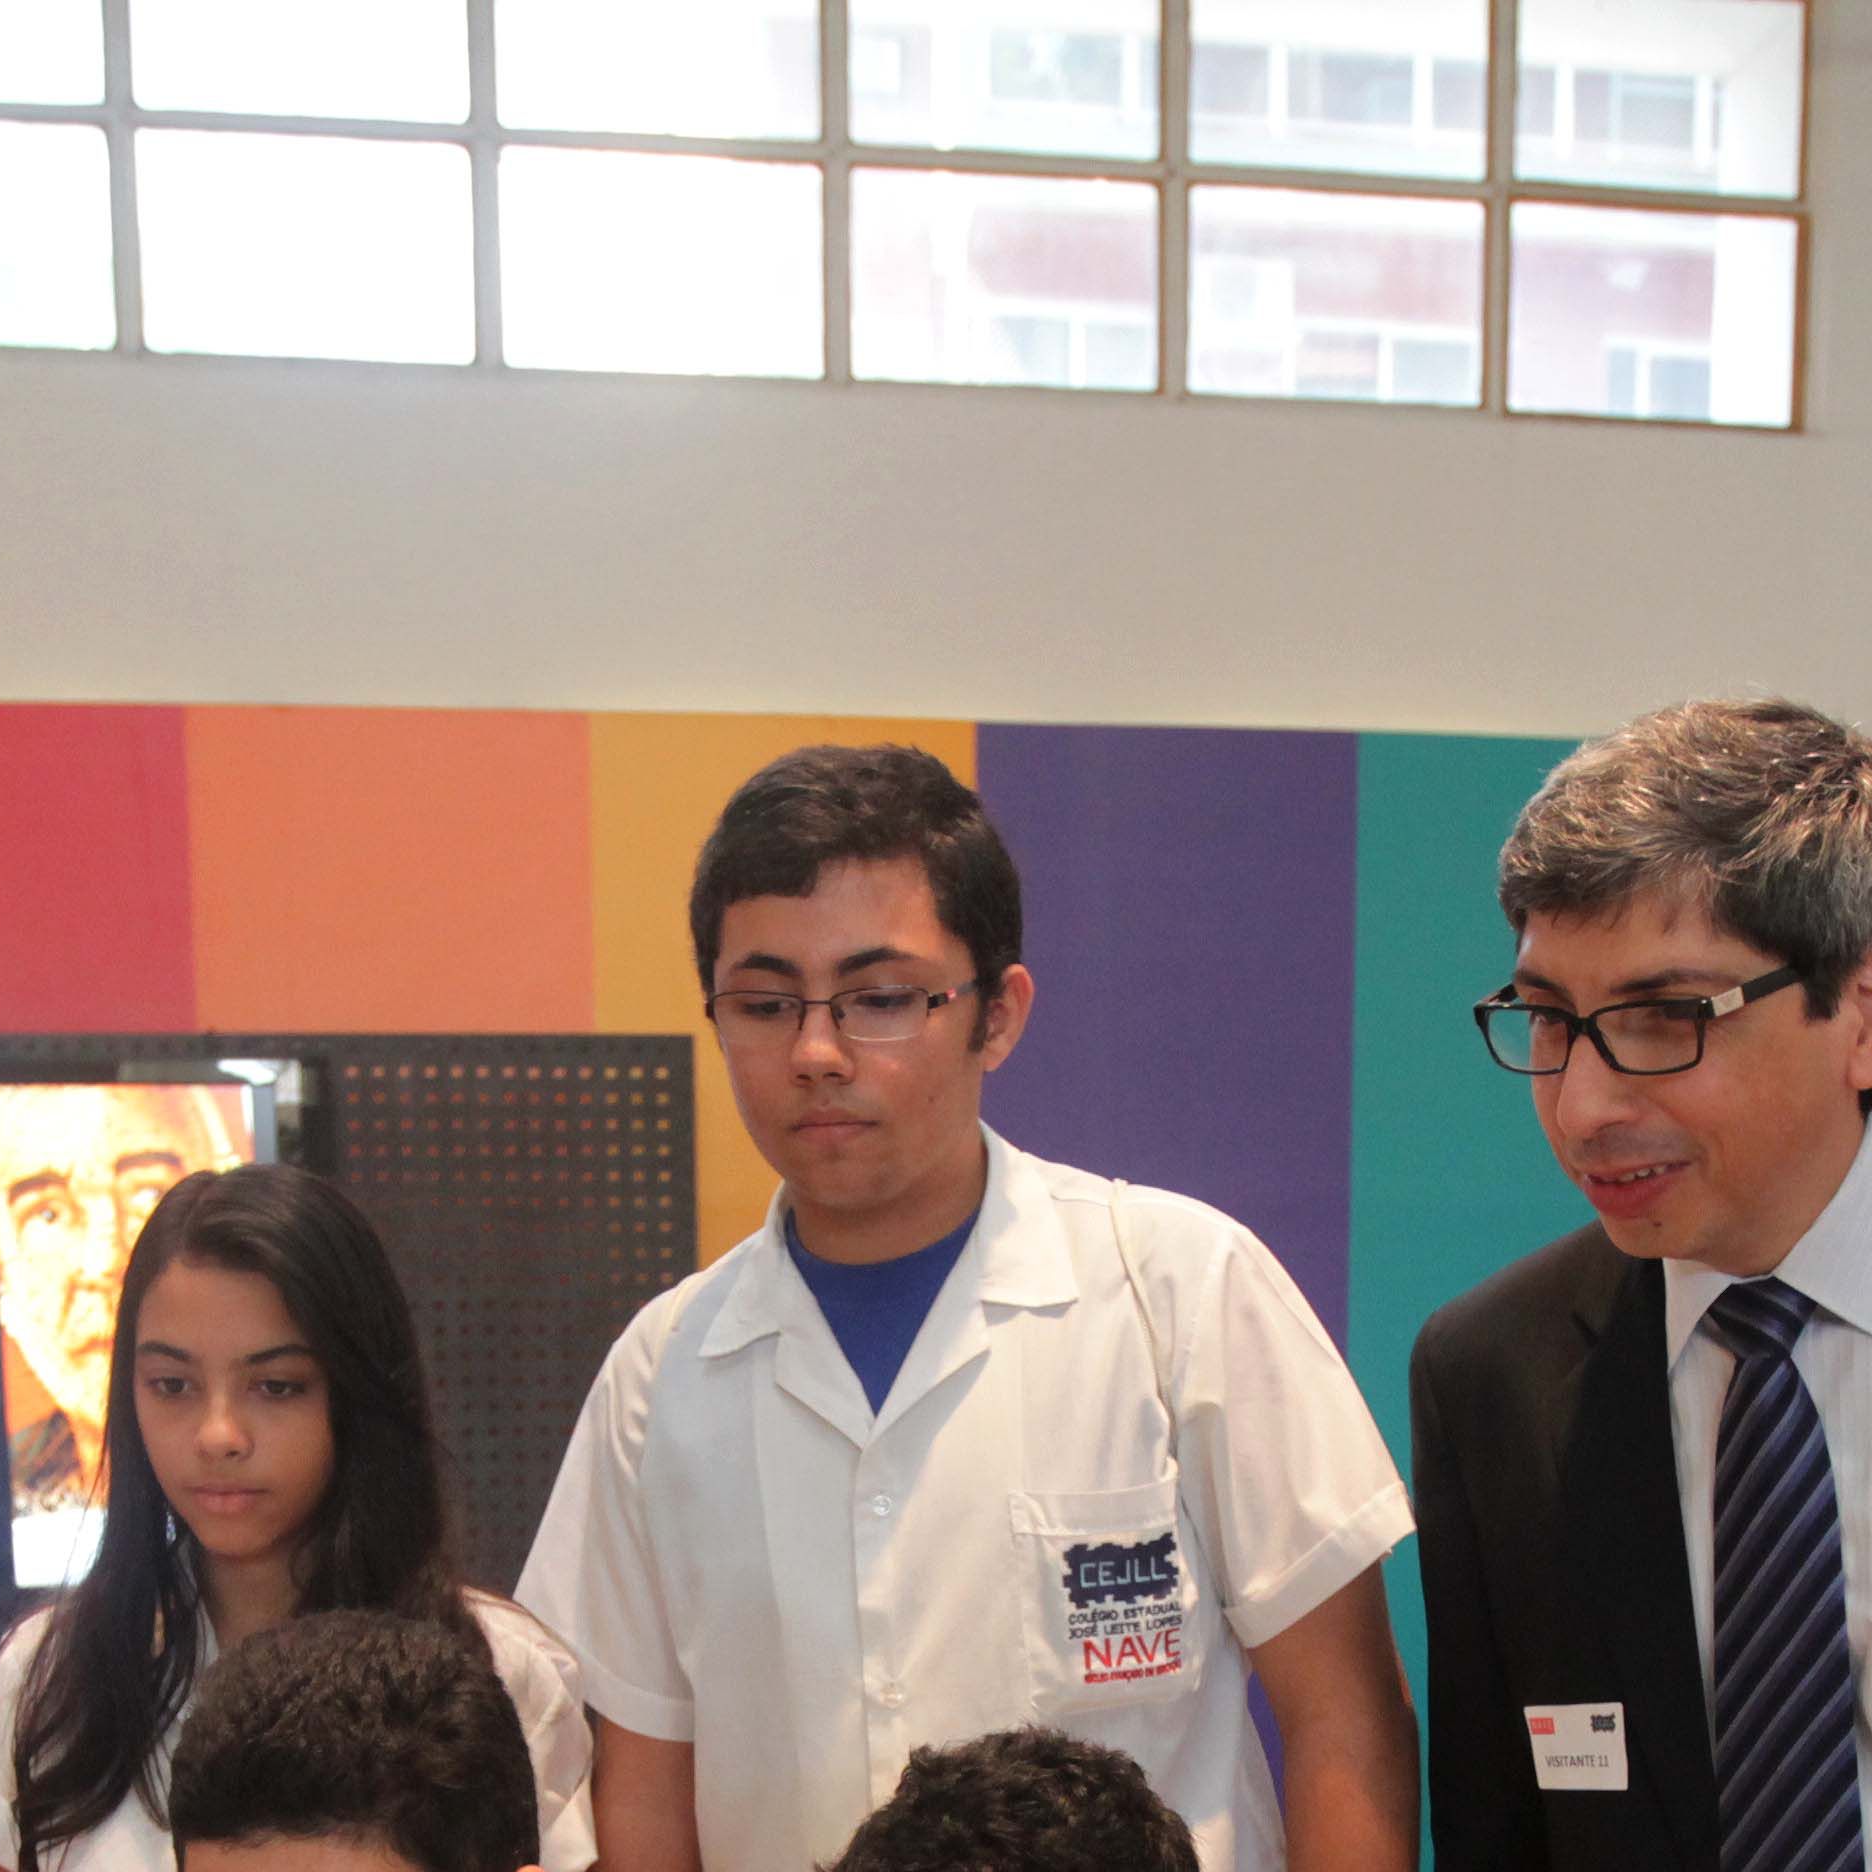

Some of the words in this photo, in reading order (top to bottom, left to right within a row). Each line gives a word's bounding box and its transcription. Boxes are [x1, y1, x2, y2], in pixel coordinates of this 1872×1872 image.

[1079, 1556, 1168, 1589] CEJLL
[1068, 1607, 1119, 1625] COLÉGIO
[1124, 1601, 1182, 1620] ESTADUAL
[1068, 1622, 1098, 1640] JOSÉ
[1104, 1621, 1141, 1636] LEITE
[1146, 1614, 1183, 1631] LOPES
[1083, 1627, 1182, 1671] NAVE
[1545, 1755, 1596, 1769] VISITANTE
